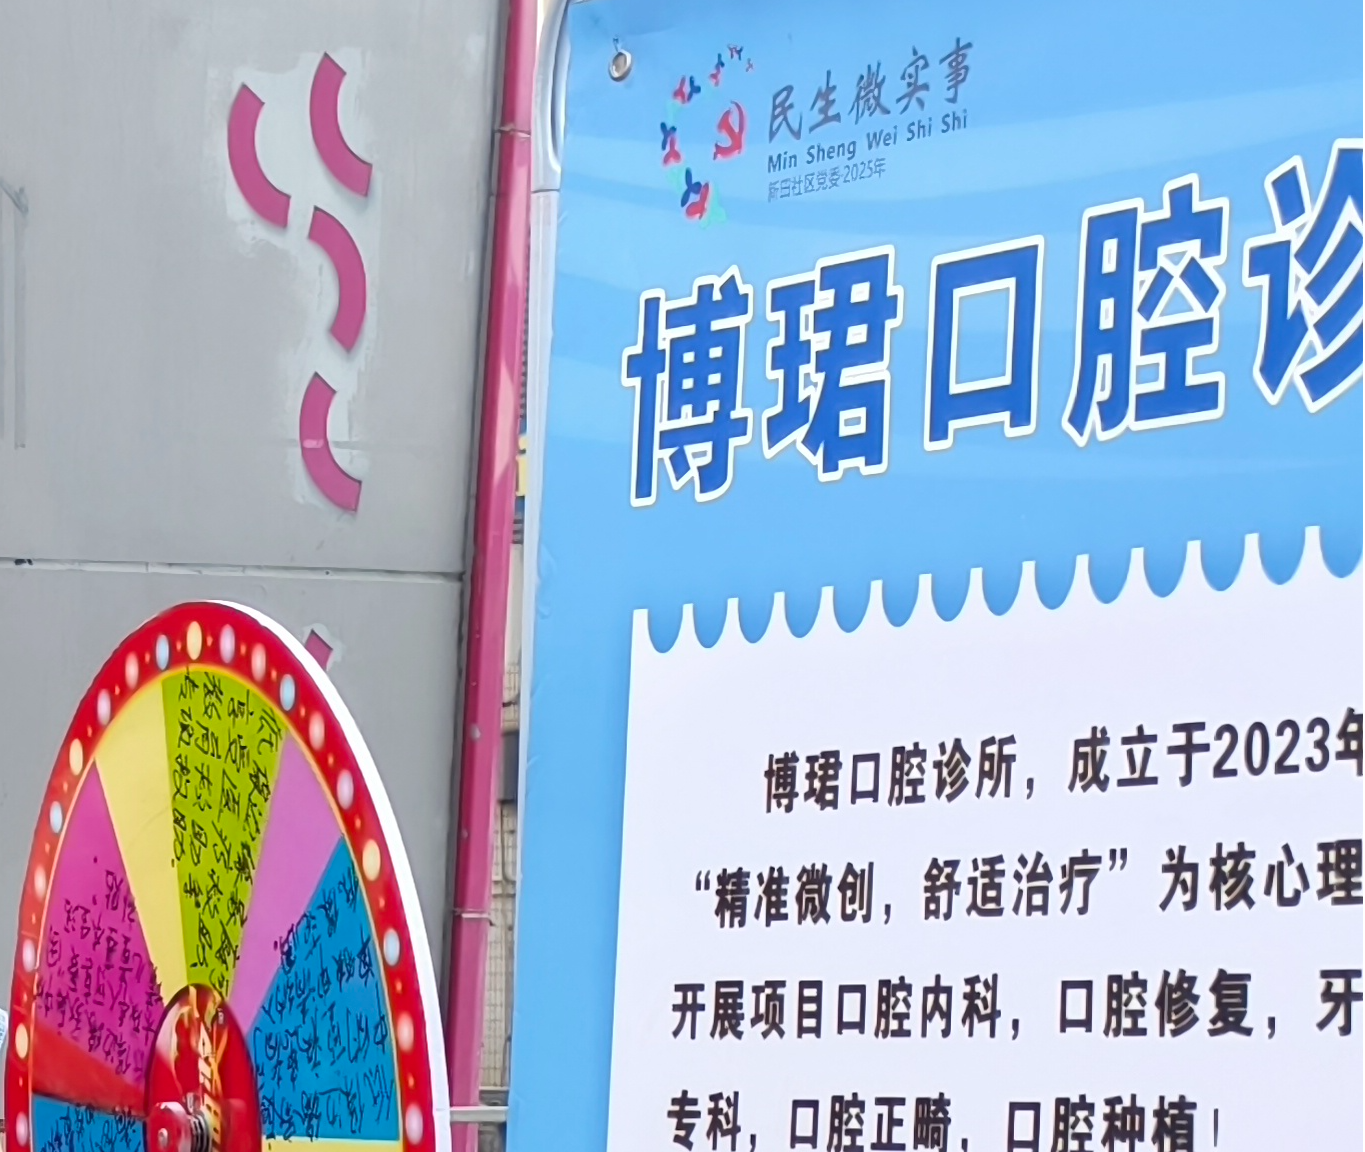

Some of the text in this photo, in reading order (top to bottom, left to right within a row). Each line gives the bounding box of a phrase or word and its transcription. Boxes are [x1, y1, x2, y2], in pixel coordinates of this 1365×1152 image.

[768, 109, 967, 173] Min Sheng Wei Shi Shi
[769, 37, 973, 143] 民生微实事
[626, 146, 1363, 501] 博珺口腔诊
